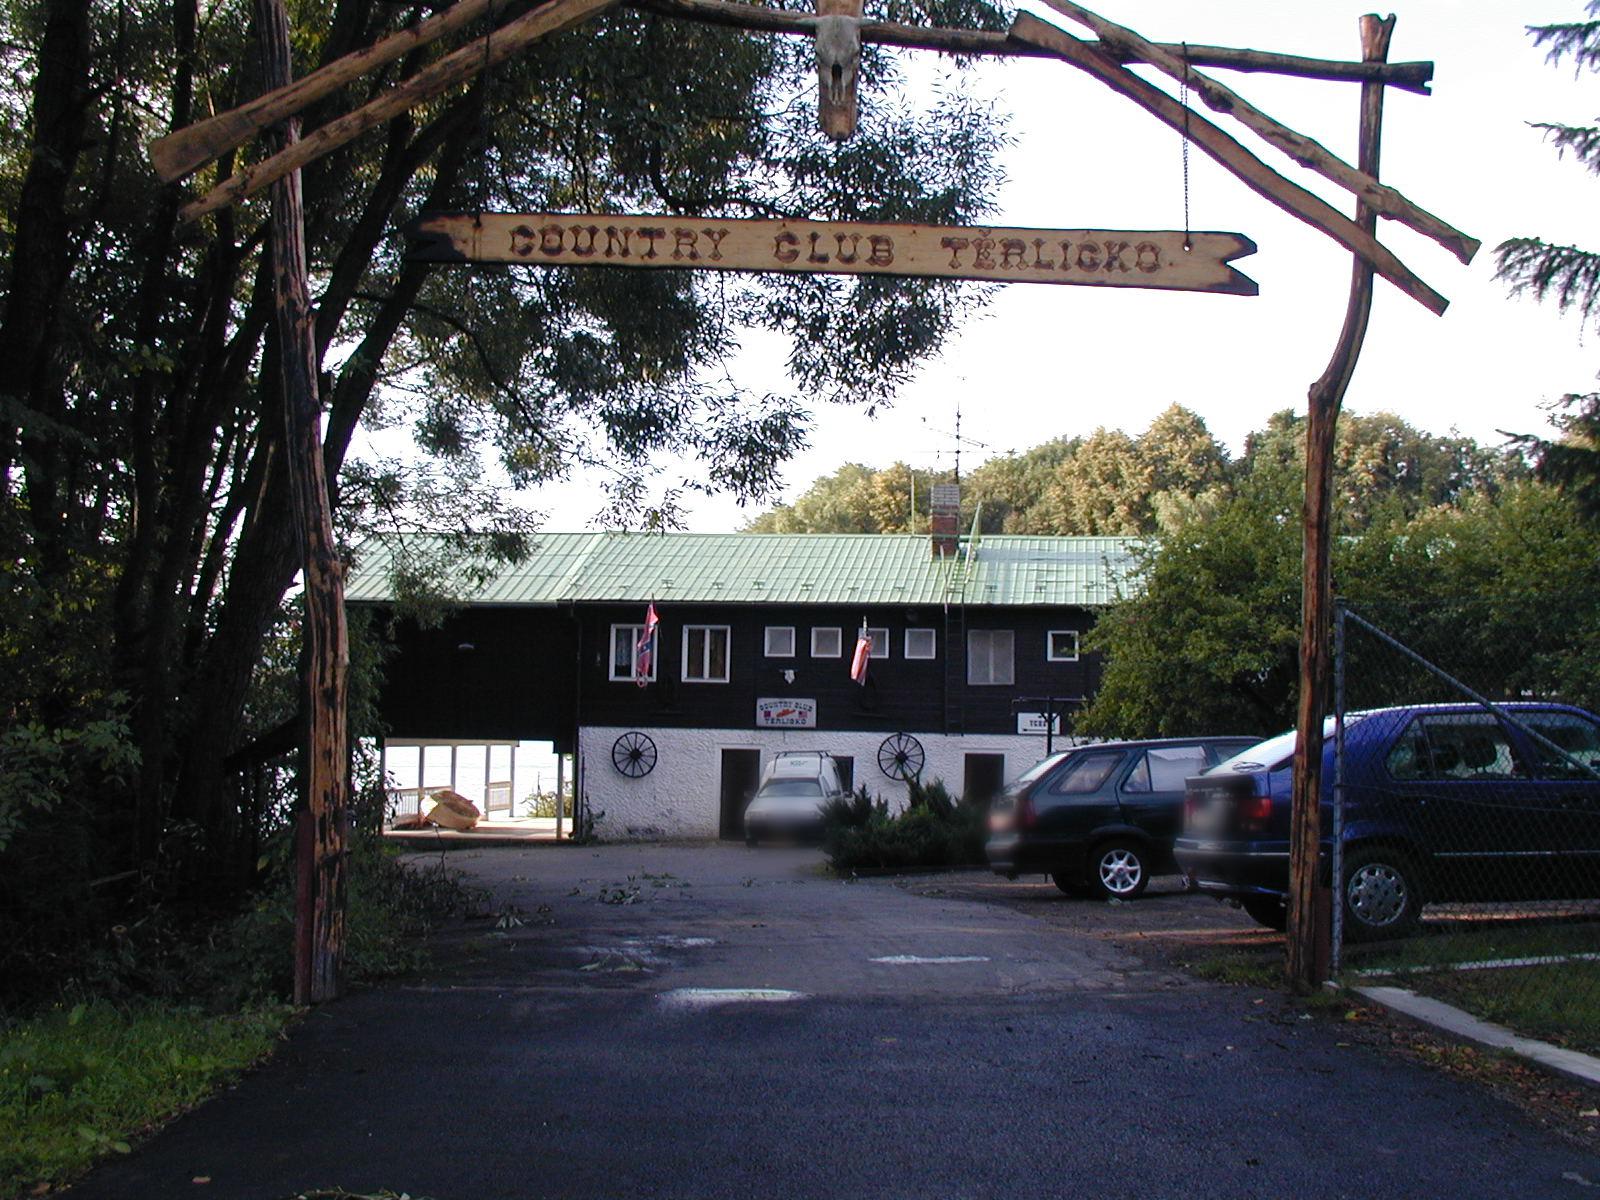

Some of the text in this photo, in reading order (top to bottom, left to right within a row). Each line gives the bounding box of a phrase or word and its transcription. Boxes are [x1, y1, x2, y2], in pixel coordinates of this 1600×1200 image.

[508, 224, 1162, 273] COUNTRY CLUB TĚRLICKO
[760, 701, 813, 712] COUNTRY CLUB
